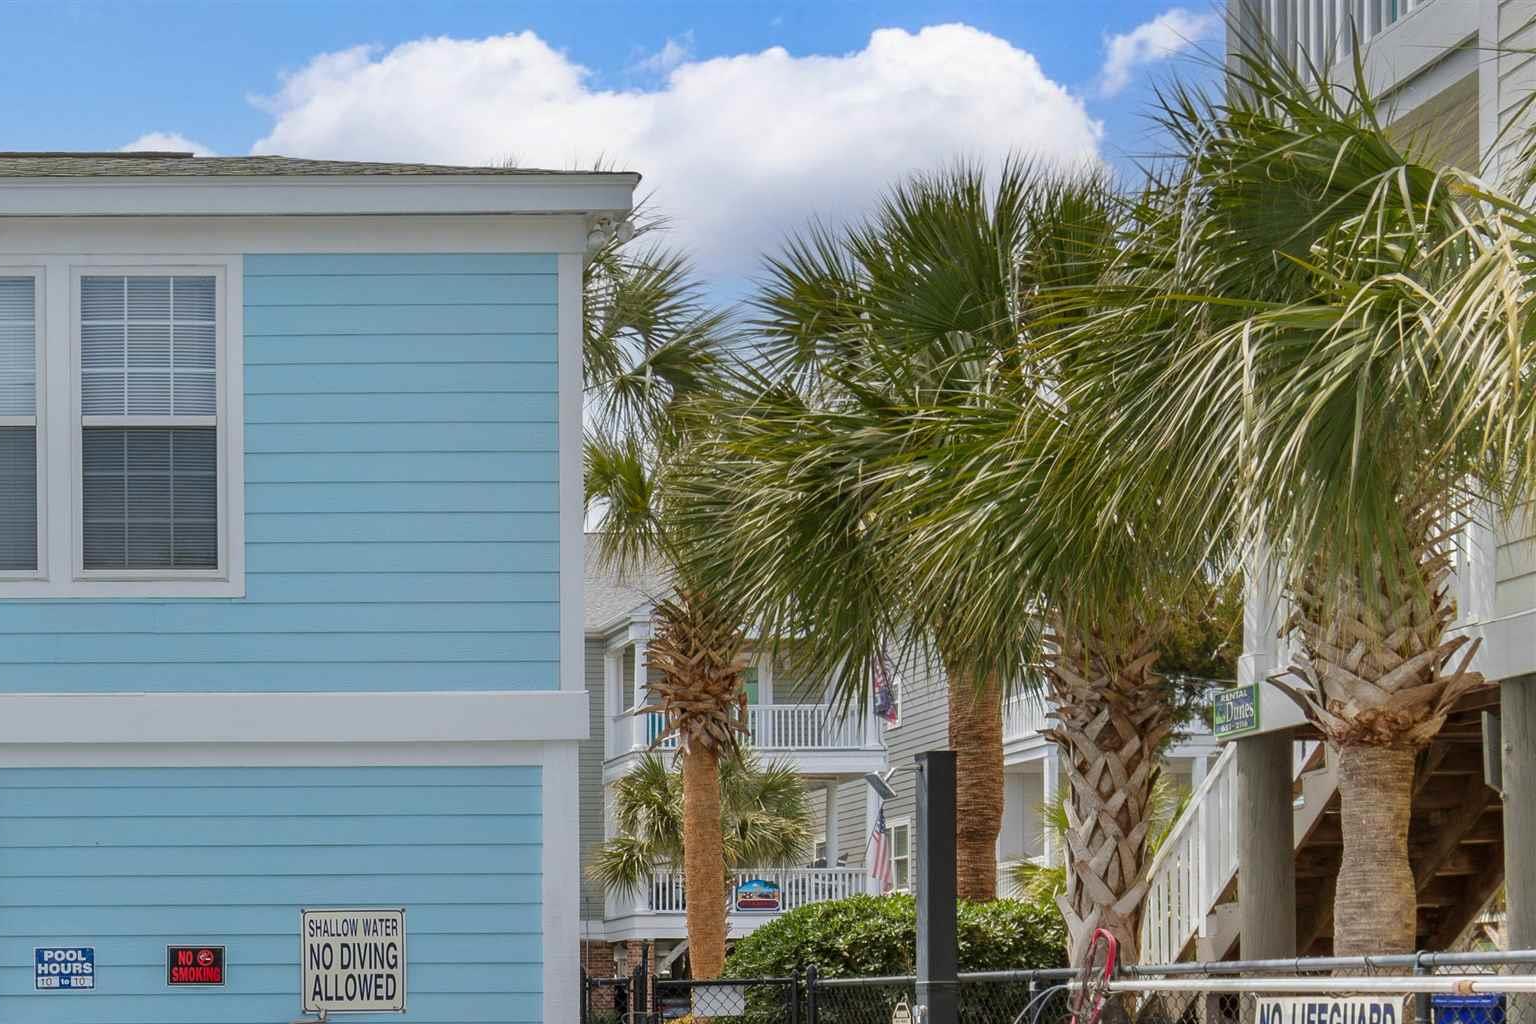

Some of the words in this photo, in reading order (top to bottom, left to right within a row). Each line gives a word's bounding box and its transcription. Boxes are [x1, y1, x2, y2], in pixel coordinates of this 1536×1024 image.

[1221, 689, 1247, 702] RENTAL
[1226, 702, 1254, 722] Dunes
[308, 918, 358, 937] SHALLOW
[362, 918, 398, 937] WATER
[43, 950, 86, 961] POOL
[178, 950, 193, 965] NO
[310, 942, 333, 970] NO
[340, 942, 398, 970] DIVING
[37, 962, 92, 974] HOURS
[172, 967, 221, 982] SMOKING
[41, 977, 52, 985] 10
[75, 977, 85, 985] 10
[312, 973, 396, 1001] ALLOWED
